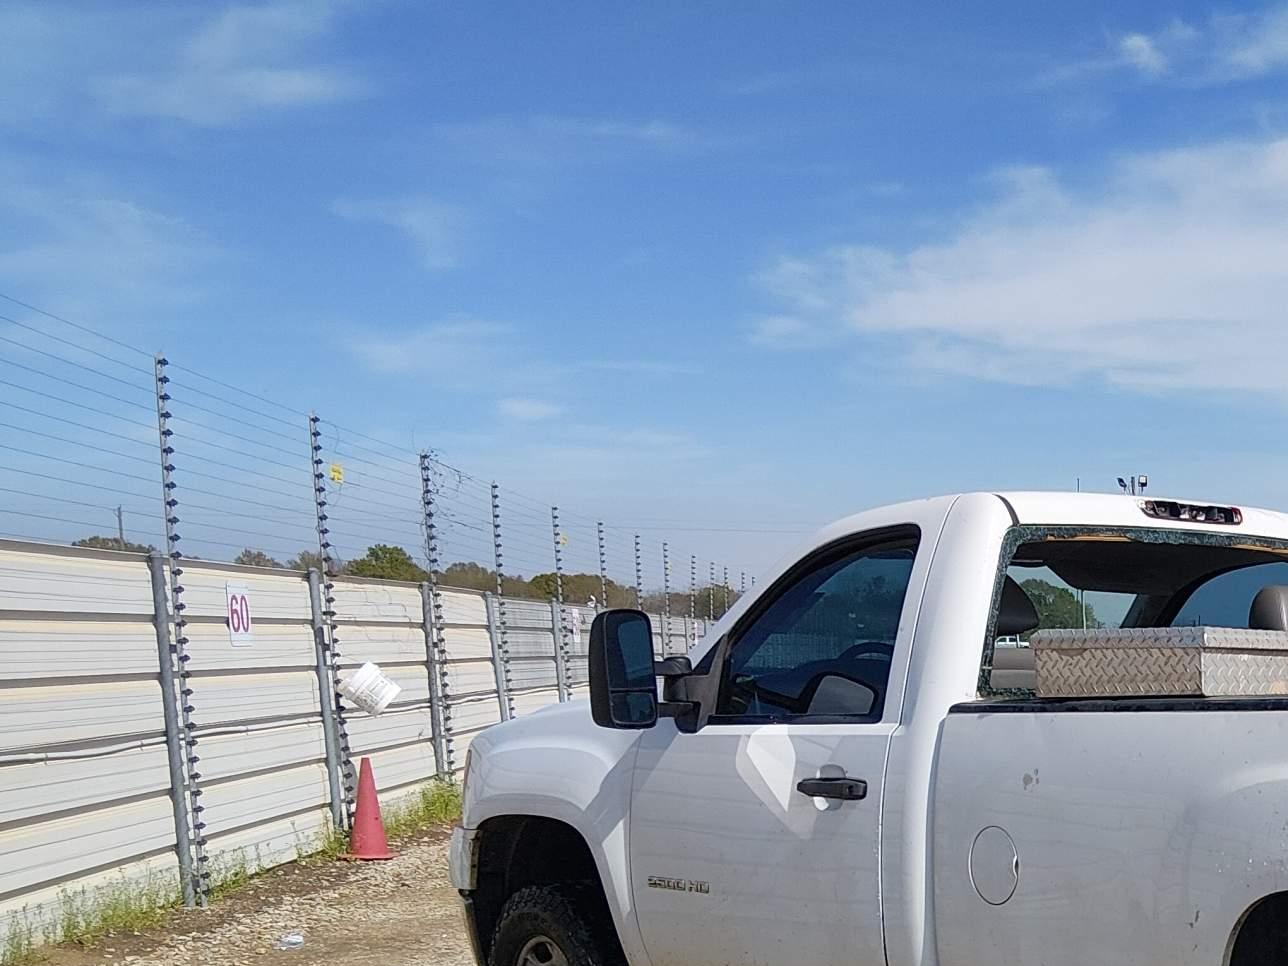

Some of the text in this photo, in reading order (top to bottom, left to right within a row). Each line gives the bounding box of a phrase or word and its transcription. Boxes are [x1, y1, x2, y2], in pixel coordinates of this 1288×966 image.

[230, 594, 250, 633] 60
[647, 875, 710, 894] 2500 HD
